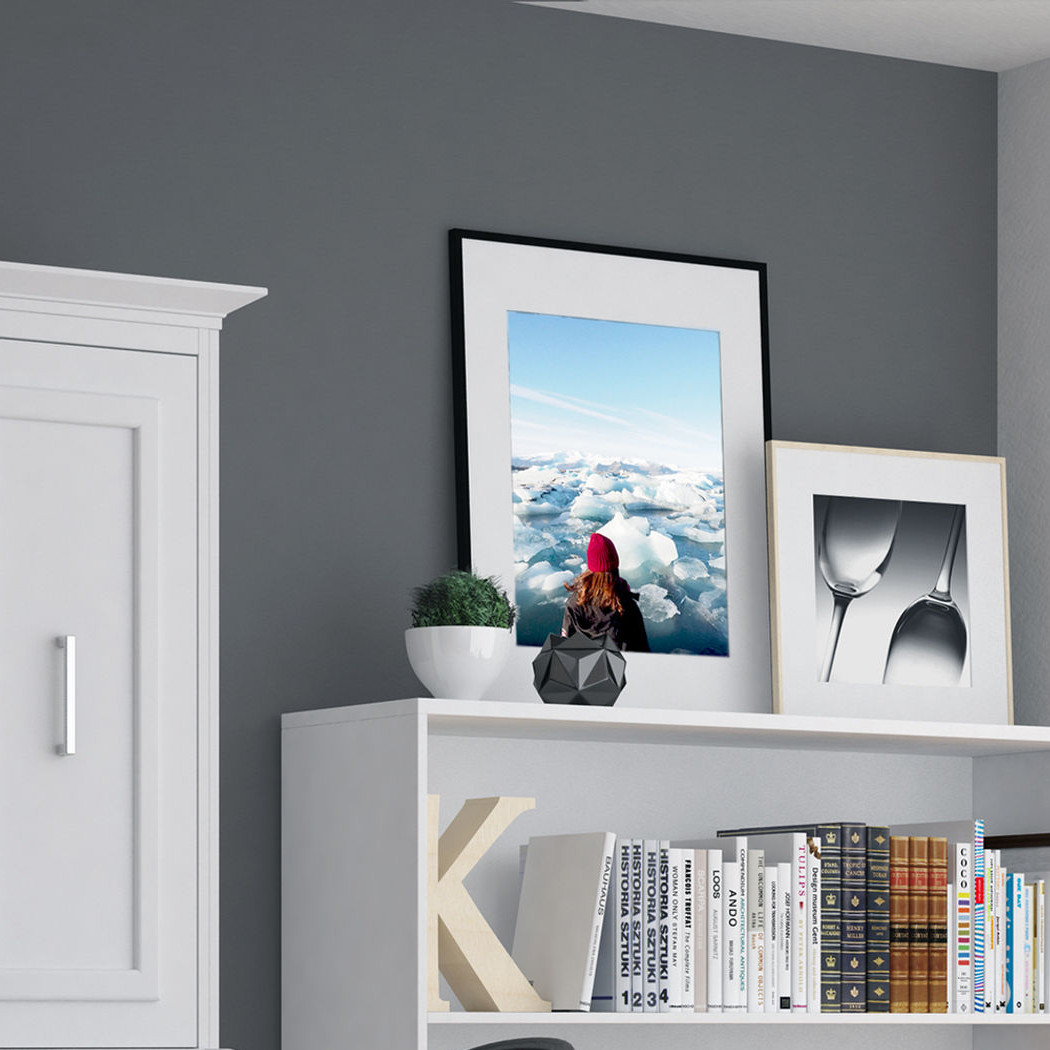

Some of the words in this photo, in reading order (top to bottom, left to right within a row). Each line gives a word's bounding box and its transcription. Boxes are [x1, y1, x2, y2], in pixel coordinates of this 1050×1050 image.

[597, 855, 612, 916] BAUHAUS
[621, 845, 630, 918] HISTORIA
[632, 844, 642, 917] HISTORIA
[647, 851, 656, 924] HISTORIA
[659, 848, 669, 921] HISTORIA
[960, 848, 968, 889] COCO
[729, 889, 737, 927] ANDO
[621, 921, 630, 978] SZTUKI
[632, 920, 642, 976] SZTUKI
[647, 927, 656, 984] SZTUKI
[659, 924, 669, 980] SZTUKI
[621, 990, 630, 1005] 1
[632, 992, 642, 1007] 2
[647, 992, 656, 1007] 3
[659, 988, 669, 1004] 4
